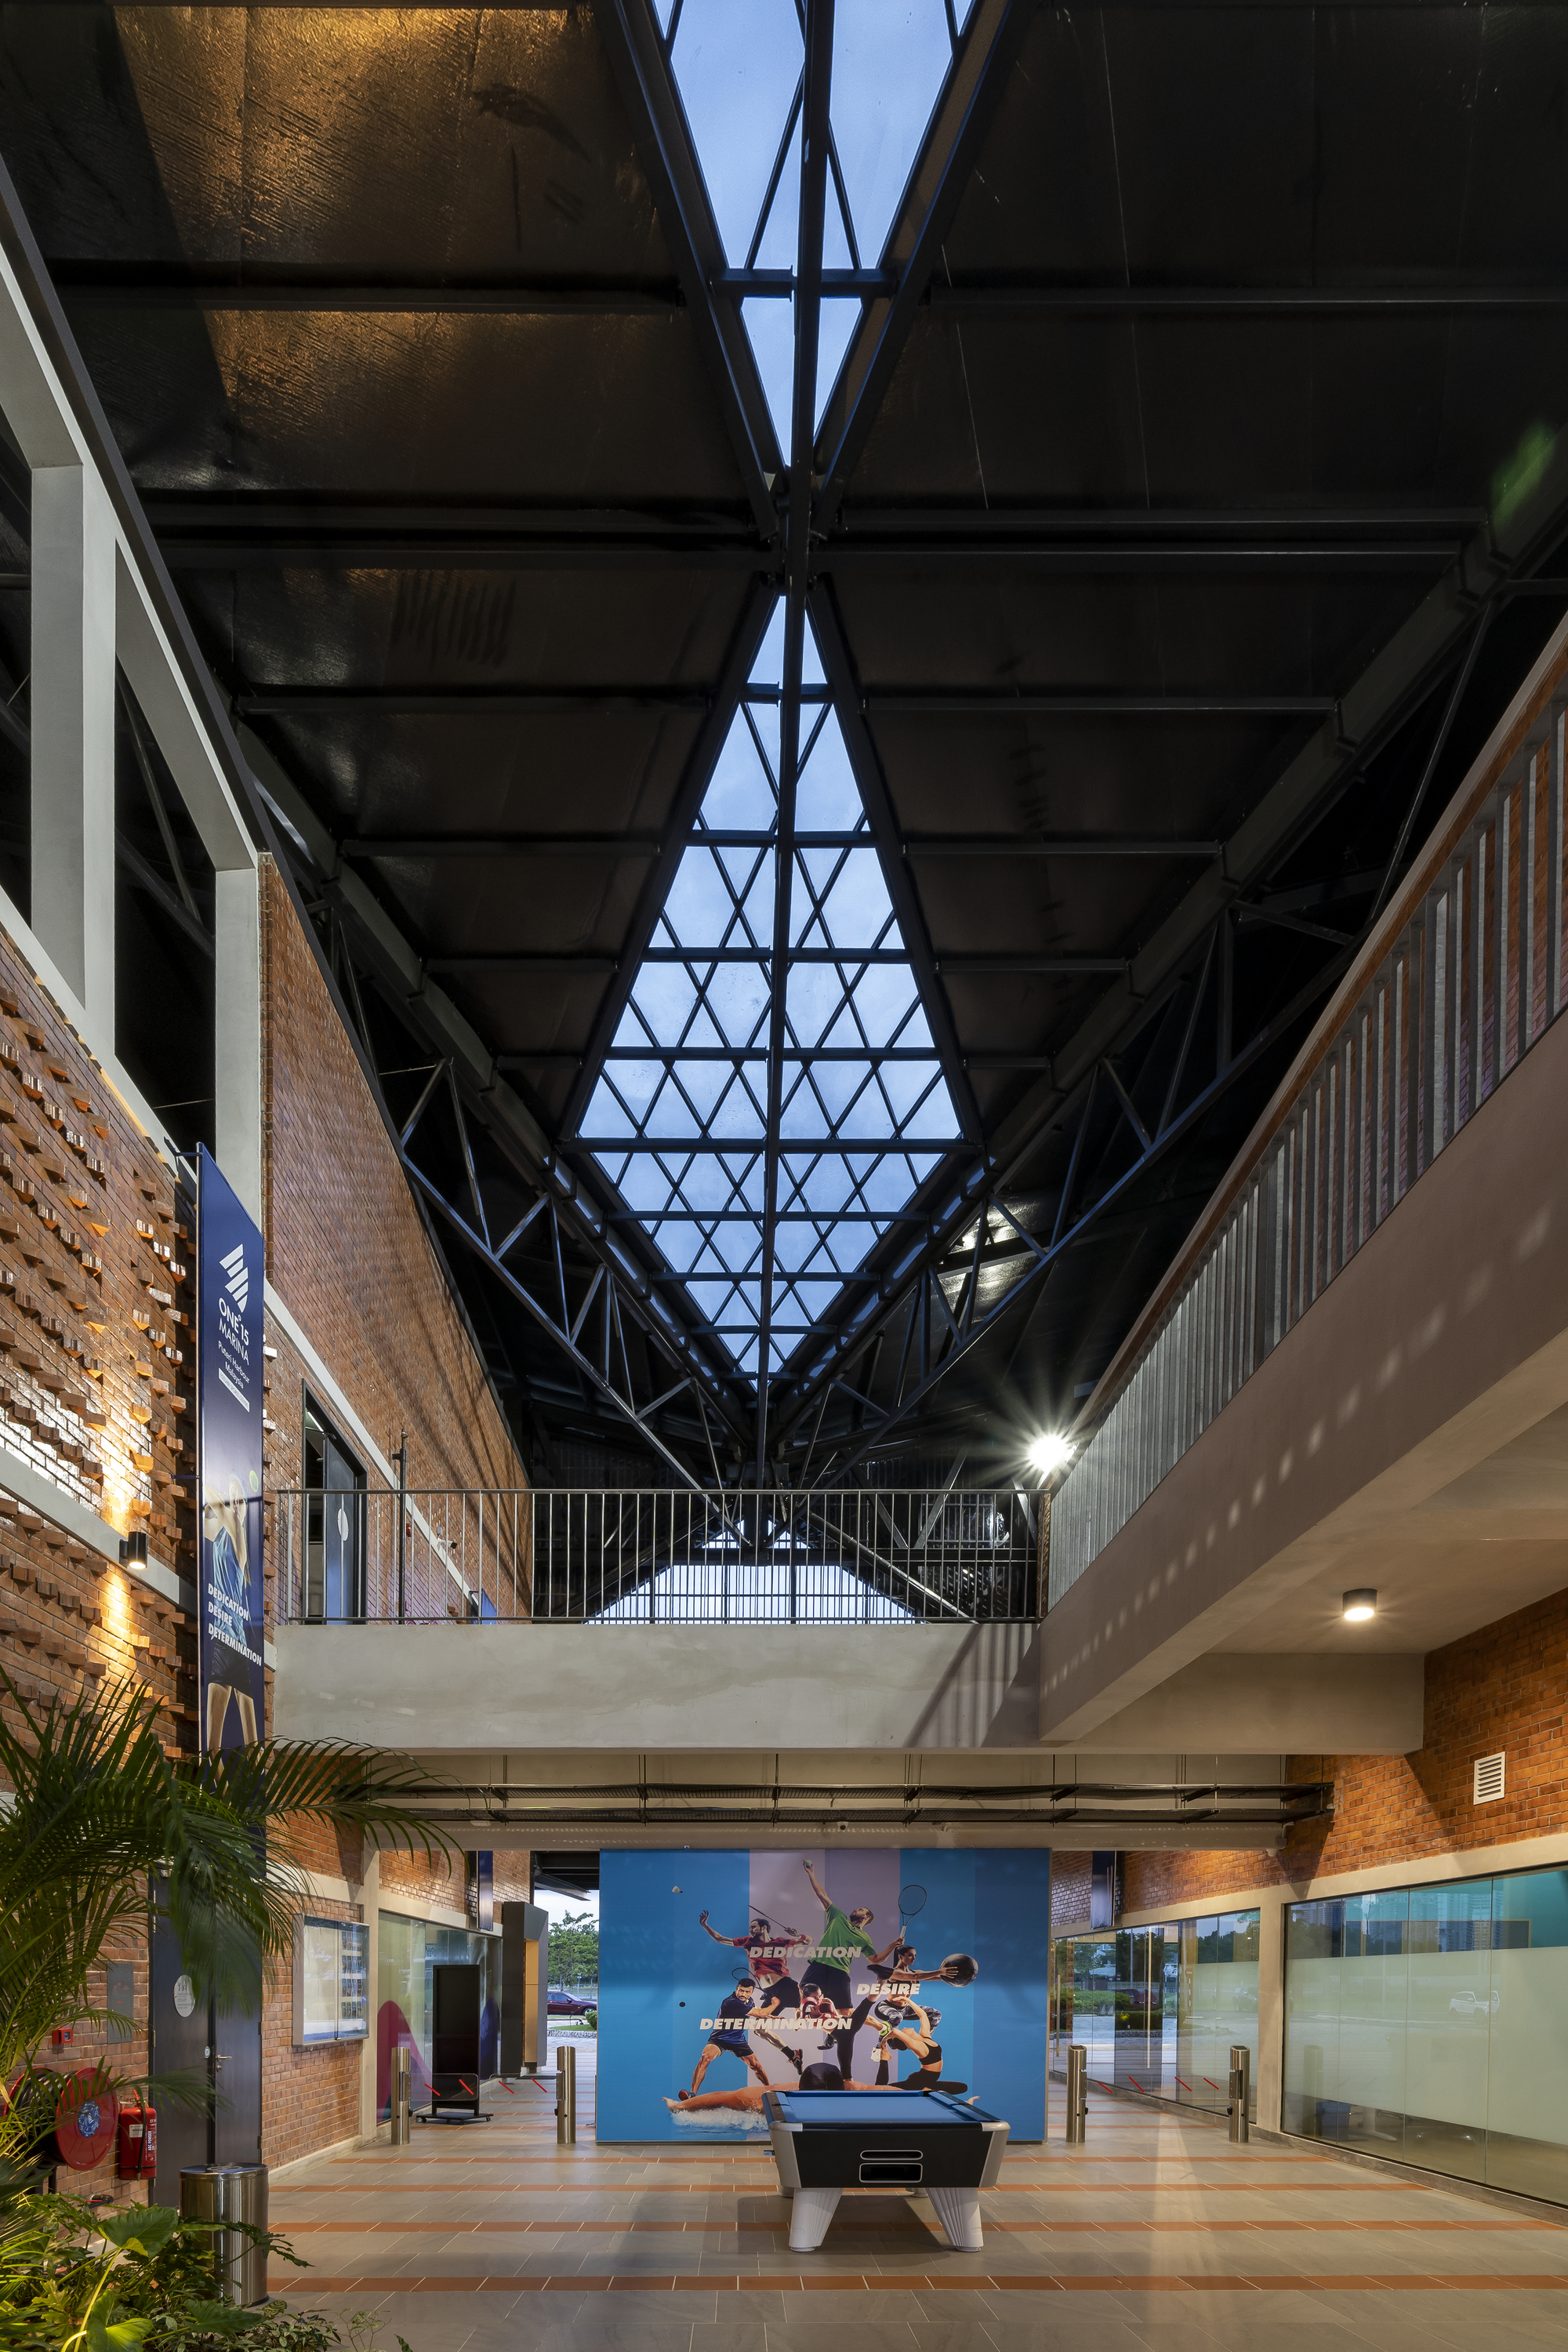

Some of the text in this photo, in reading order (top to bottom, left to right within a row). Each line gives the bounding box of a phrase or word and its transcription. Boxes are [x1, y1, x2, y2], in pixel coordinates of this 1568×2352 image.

[219, 1317, 249, 1366] MARINA
[219, 1340, 232, 1363] Puteri
[232, 1357, 249, 1384] Harbour
[225, 1361, 244, 1389] Malaysia
[209, 1583, 249, 1621] DEDICATION
[209, 1602, 232, 1626] DESIRE
[209, 1623, 261, 1666] DETERMINATION
[749, 1946, 862, 1959] DEDICATION
[856, 1983, 921, 1995] DESIRE
[699, 2017, 853, 2031] DETERMINATION
